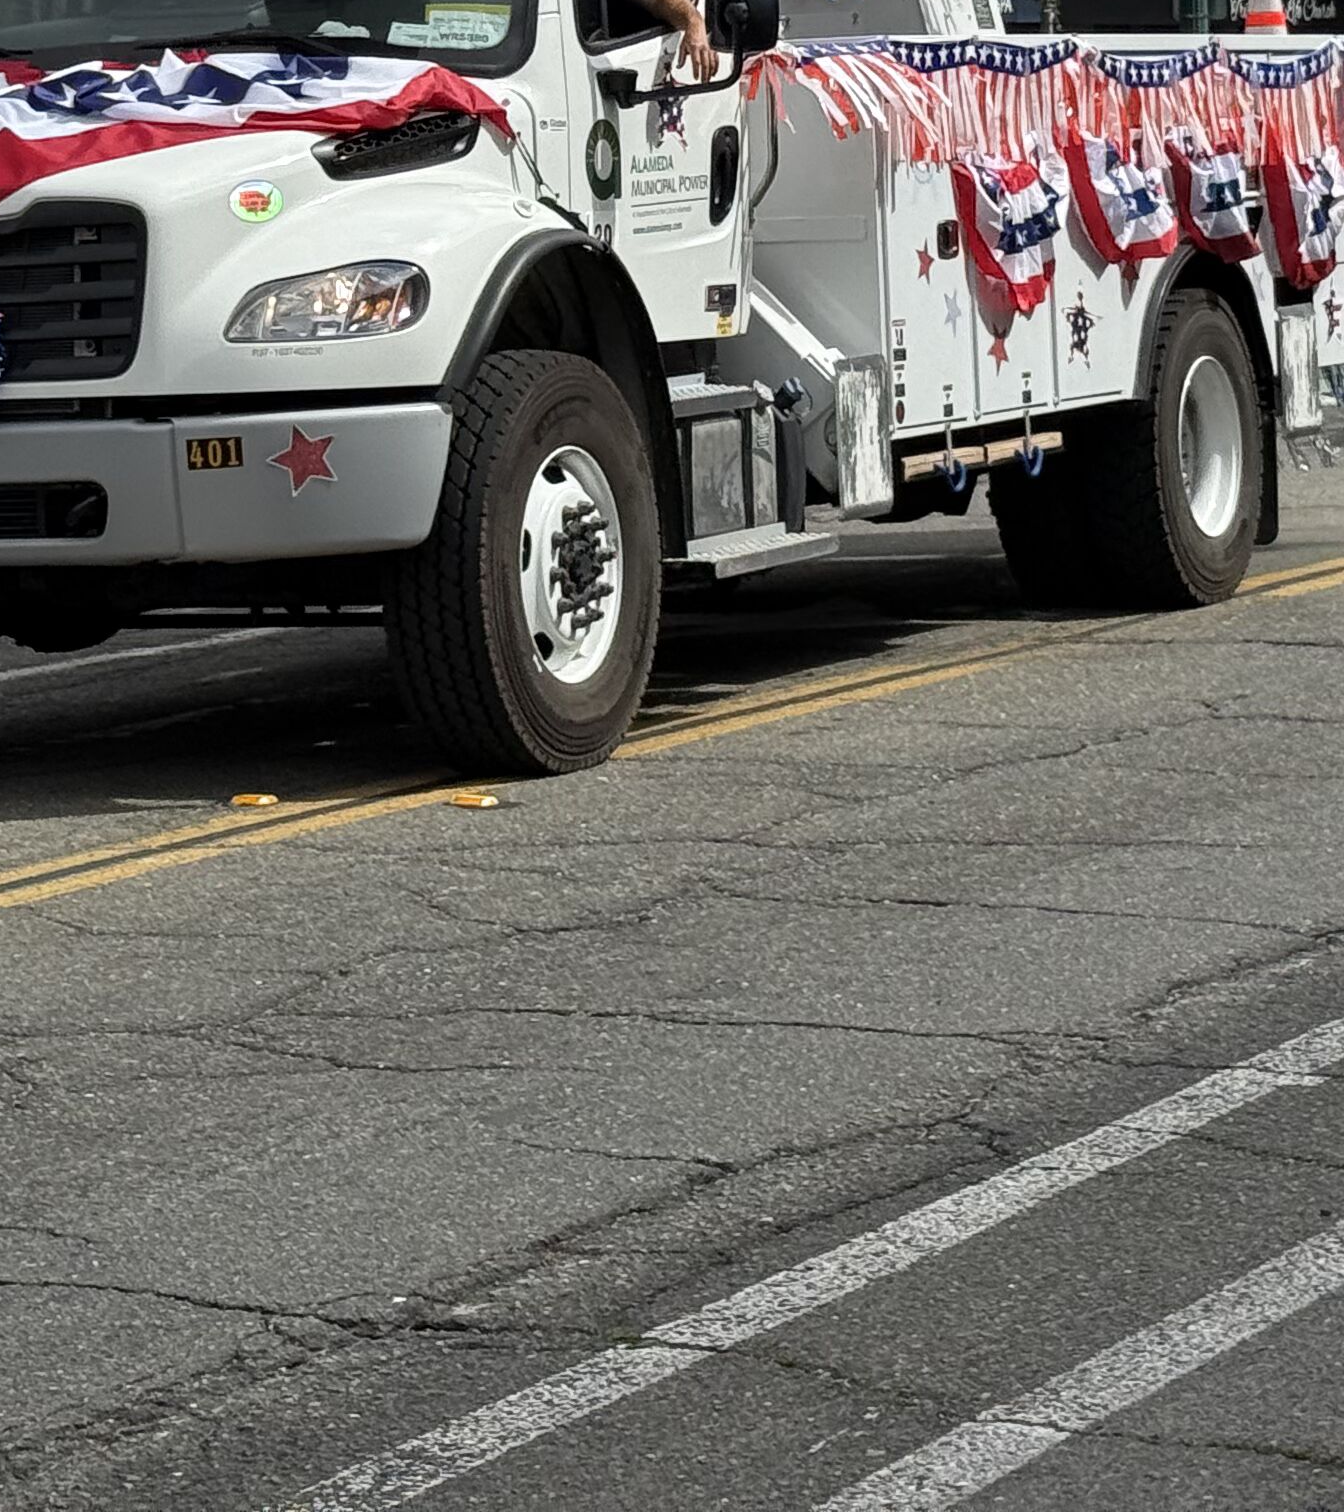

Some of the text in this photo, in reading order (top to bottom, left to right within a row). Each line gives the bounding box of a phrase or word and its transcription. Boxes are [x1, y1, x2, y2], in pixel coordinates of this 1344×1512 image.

[630, 154, 674, 174] ALAMEDA
[631, 174, 708, 197] MUNICIPAL POWER
[190, 438, 240, 468] 401
